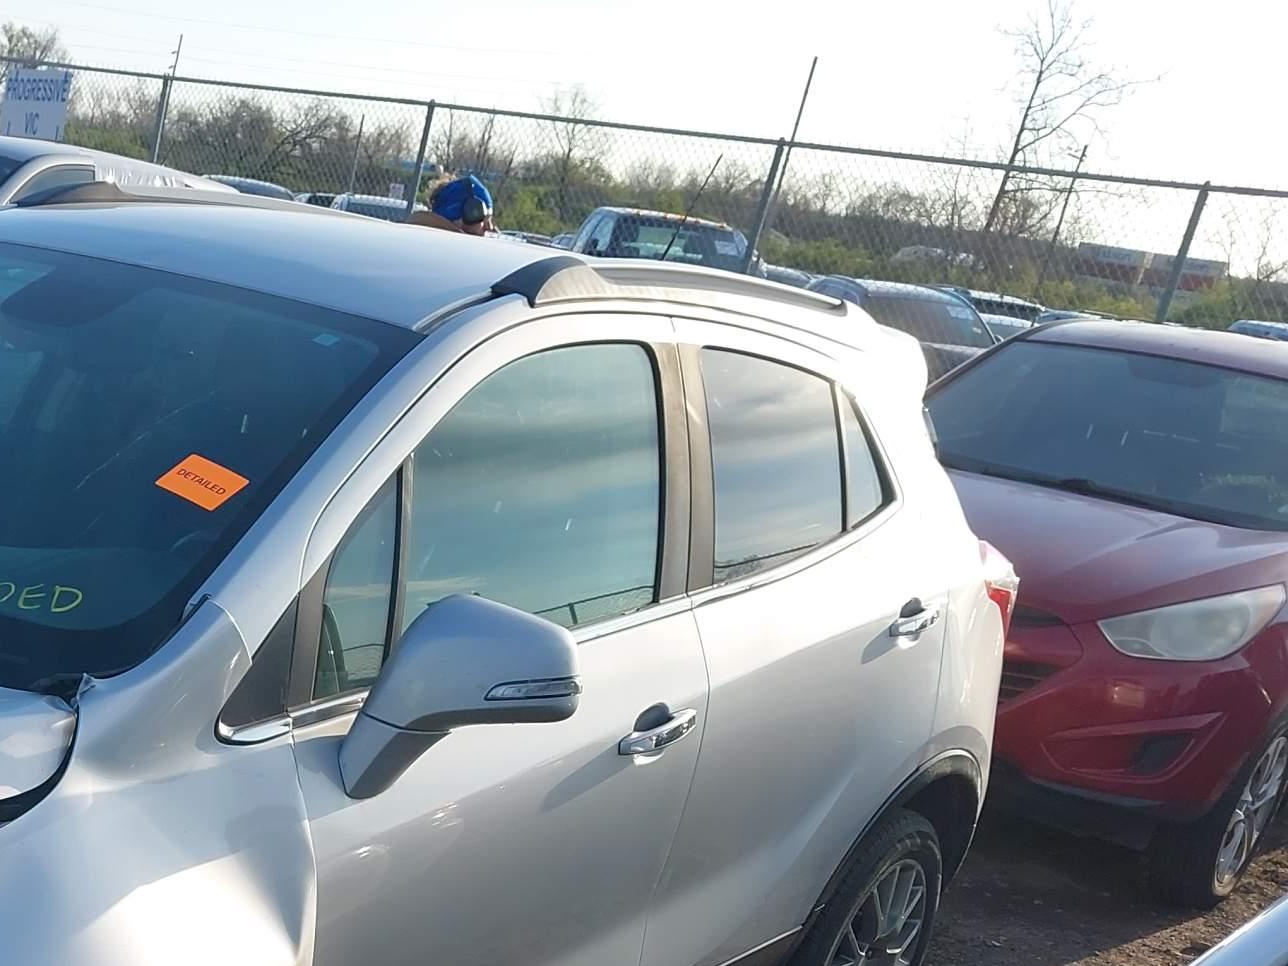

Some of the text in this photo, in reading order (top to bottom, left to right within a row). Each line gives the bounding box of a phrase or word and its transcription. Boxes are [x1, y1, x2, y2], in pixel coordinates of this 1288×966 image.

[7, 78, 69, 102] PROGRESSIVE
[24, 111, 40, 135] VIC
[176, 468, 226, 495] DETAILED
